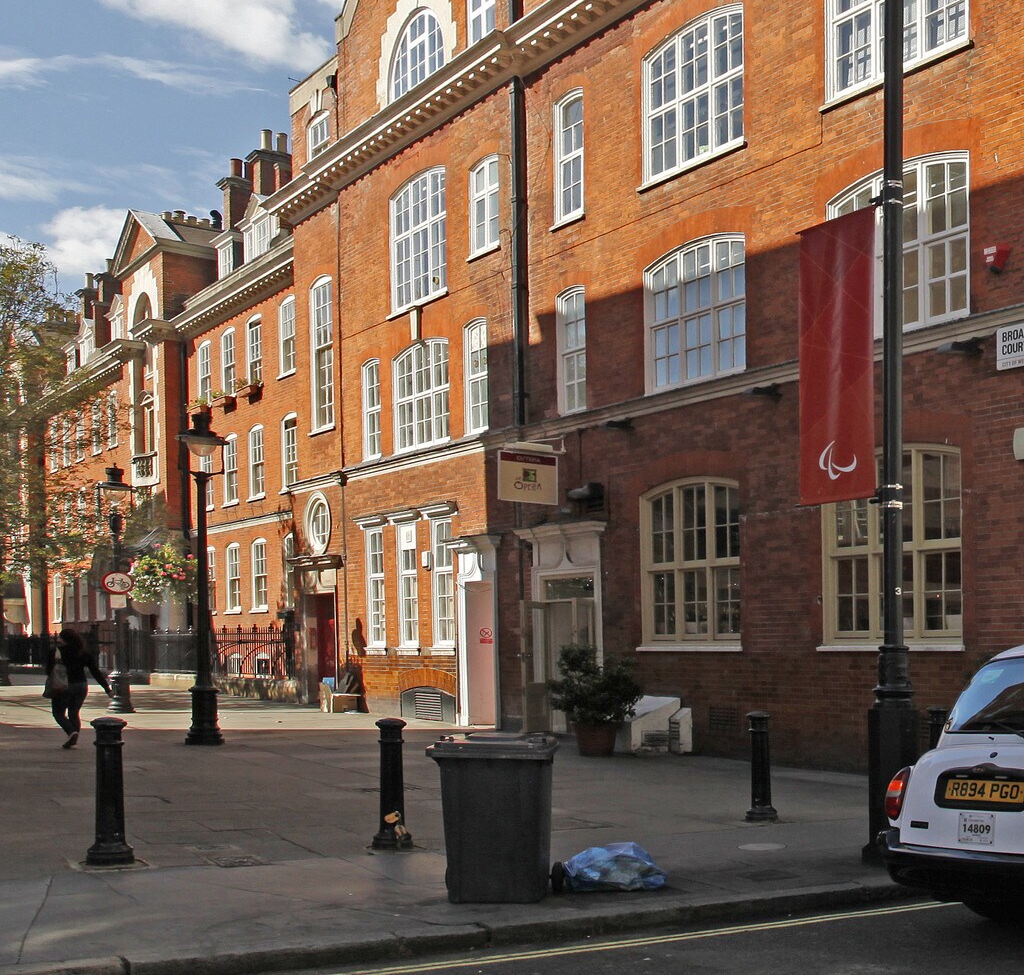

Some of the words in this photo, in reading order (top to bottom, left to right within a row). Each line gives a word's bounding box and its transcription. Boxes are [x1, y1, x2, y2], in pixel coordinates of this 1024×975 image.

[895, 587, 902, 595] 3
[951, 782, 986, 797] R894
[989, 784, 1020, 800] PGO
[963, 823, 991, 834] 14809
